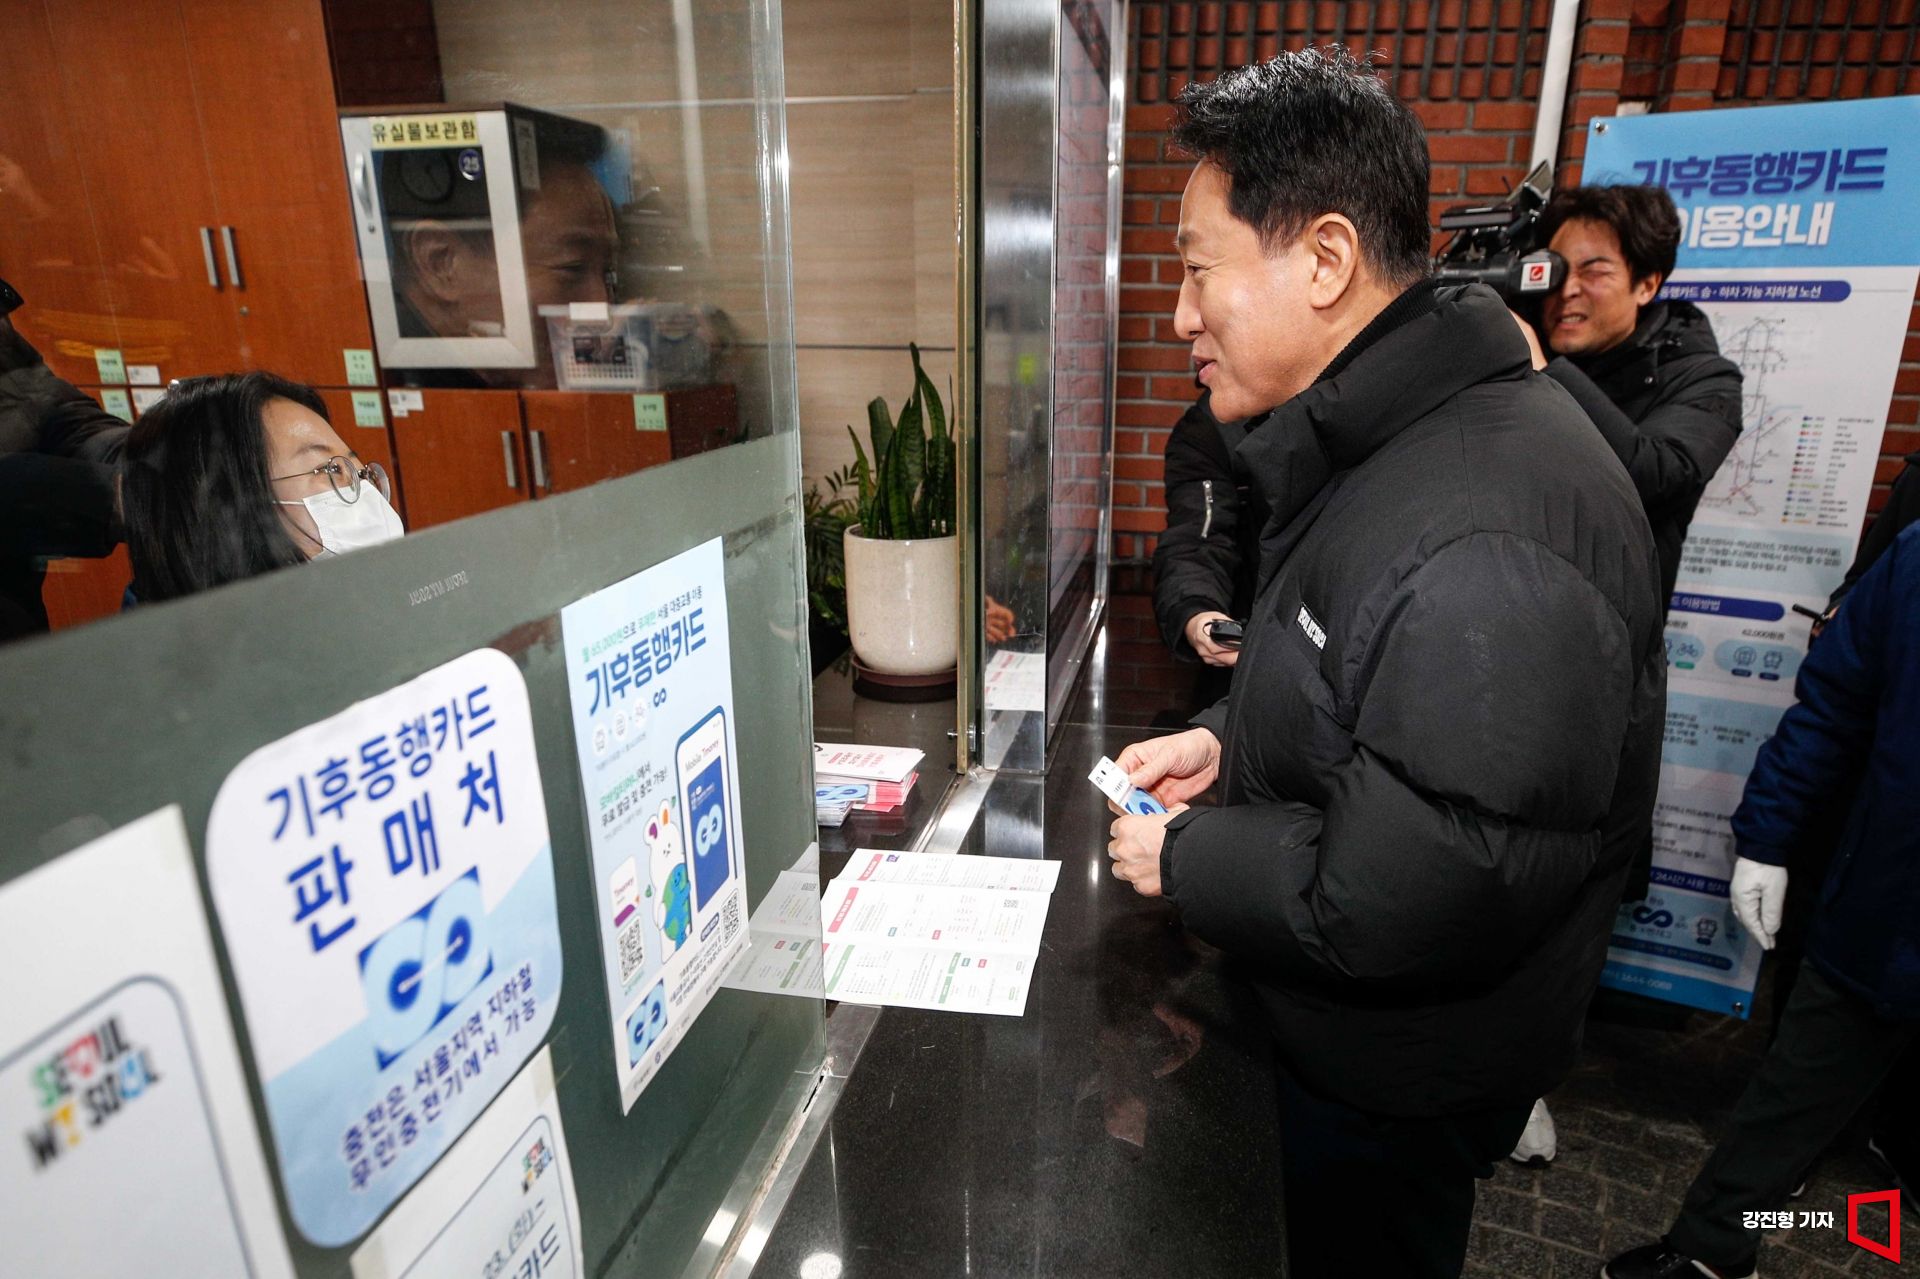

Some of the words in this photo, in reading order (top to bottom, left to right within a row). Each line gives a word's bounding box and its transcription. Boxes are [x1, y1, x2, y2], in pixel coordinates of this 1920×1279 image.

[372, 120, 476, 142] 유실물보관함
[463, 156, 480, 173] 25
[1632, 147, 1888, 199] 기후동행카드
[1677, 201, 1836, 249] 이용안내
[1659, 285, 1699, 300] 동행카드
[585, 607, 707, 718] 기후동행카드
[266, 684, 498, 842] 기후동행카드
[504, 996, 536, 1037] 가능
[344, 1085, 407, 1161] 충전은
[412, 1010, 485, 1092] 서울지역
[487, 962, 533, 1020] 지하철
